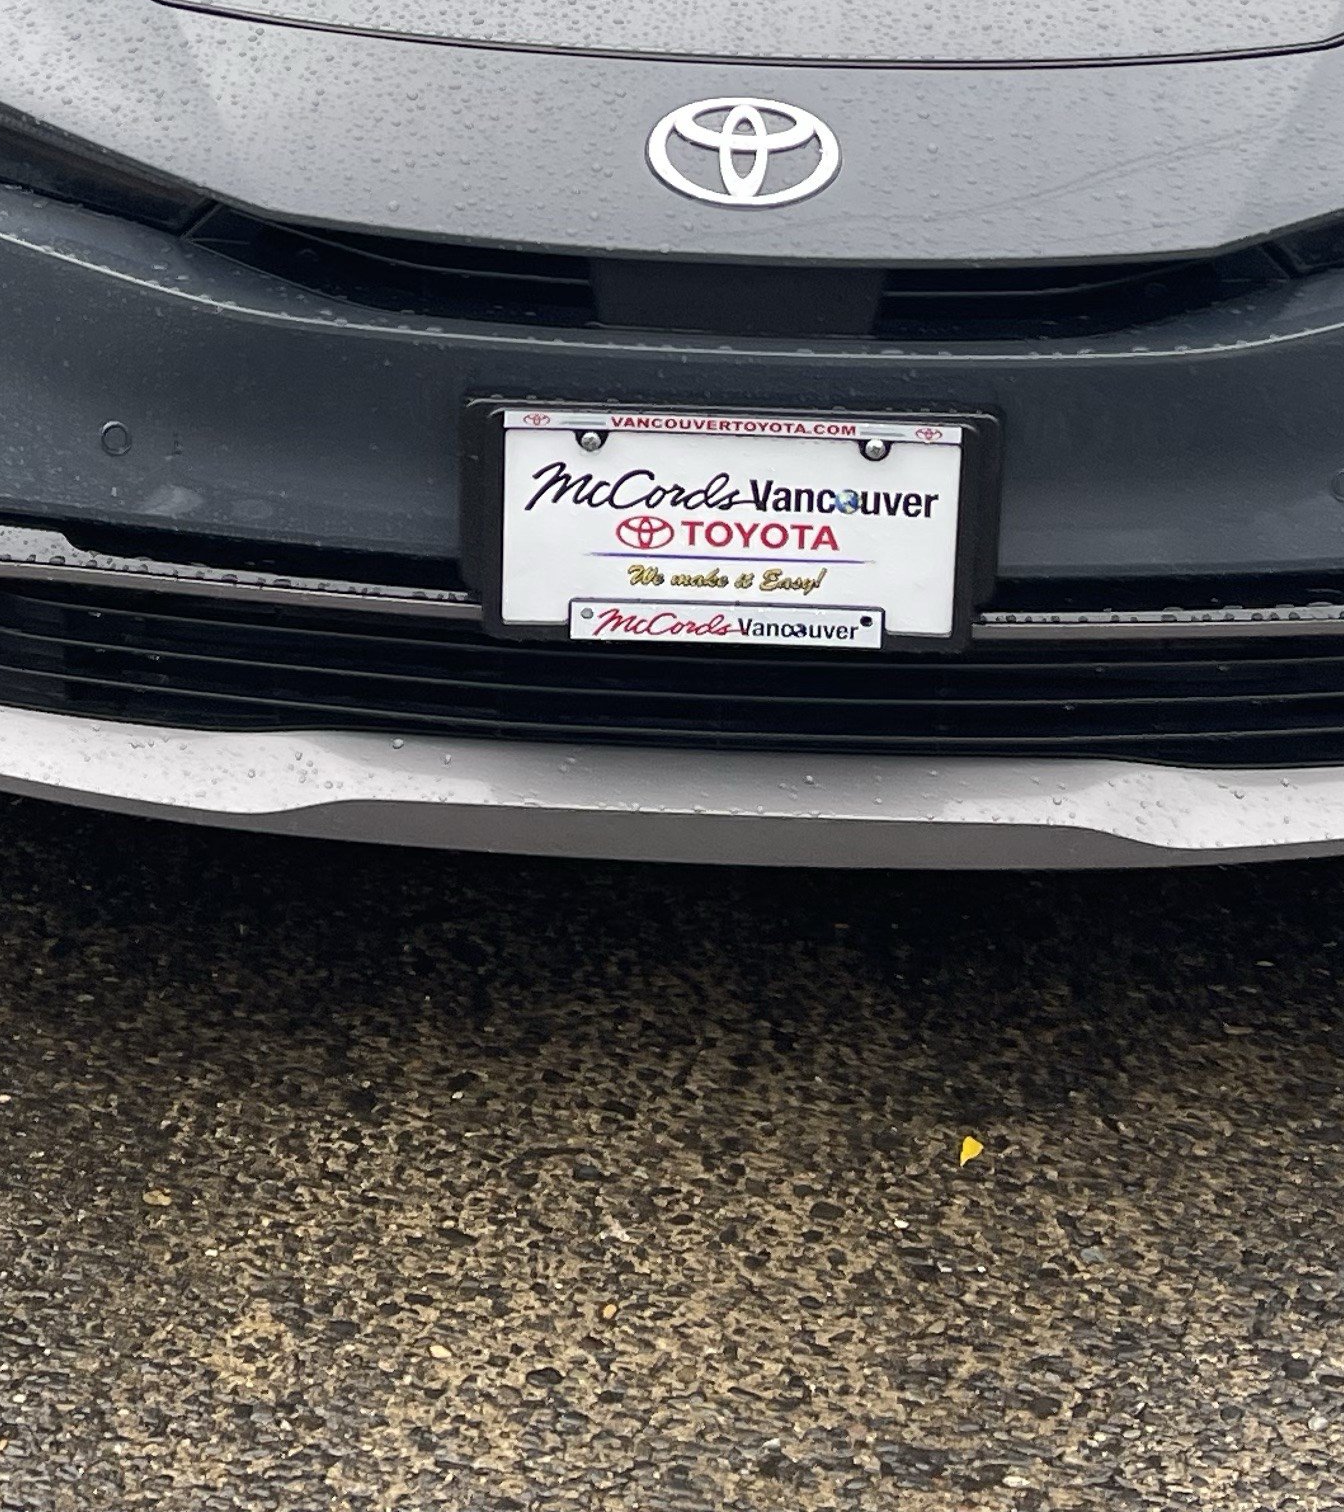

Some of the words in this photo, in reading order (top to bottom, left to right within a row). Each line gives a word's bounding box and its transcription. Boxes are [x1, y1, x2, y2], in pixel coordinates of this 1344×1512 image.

[610, 415, 857, 436] VANCOUVERTOYOTA.COM
[524, 460, 754, 512] McCords
[749, 479, 940, 519] Vancouver
[680, 520, 841, 552] TOYOTA
[627, 564, 665, 587] We
[669, 568, 729, 588] make
[734, 570, 755, 588] it
[759, 567, 828, 596] Easy!
[592, 608, 746, 637] McCords
[737, 617, 860, 641] Vancouver
